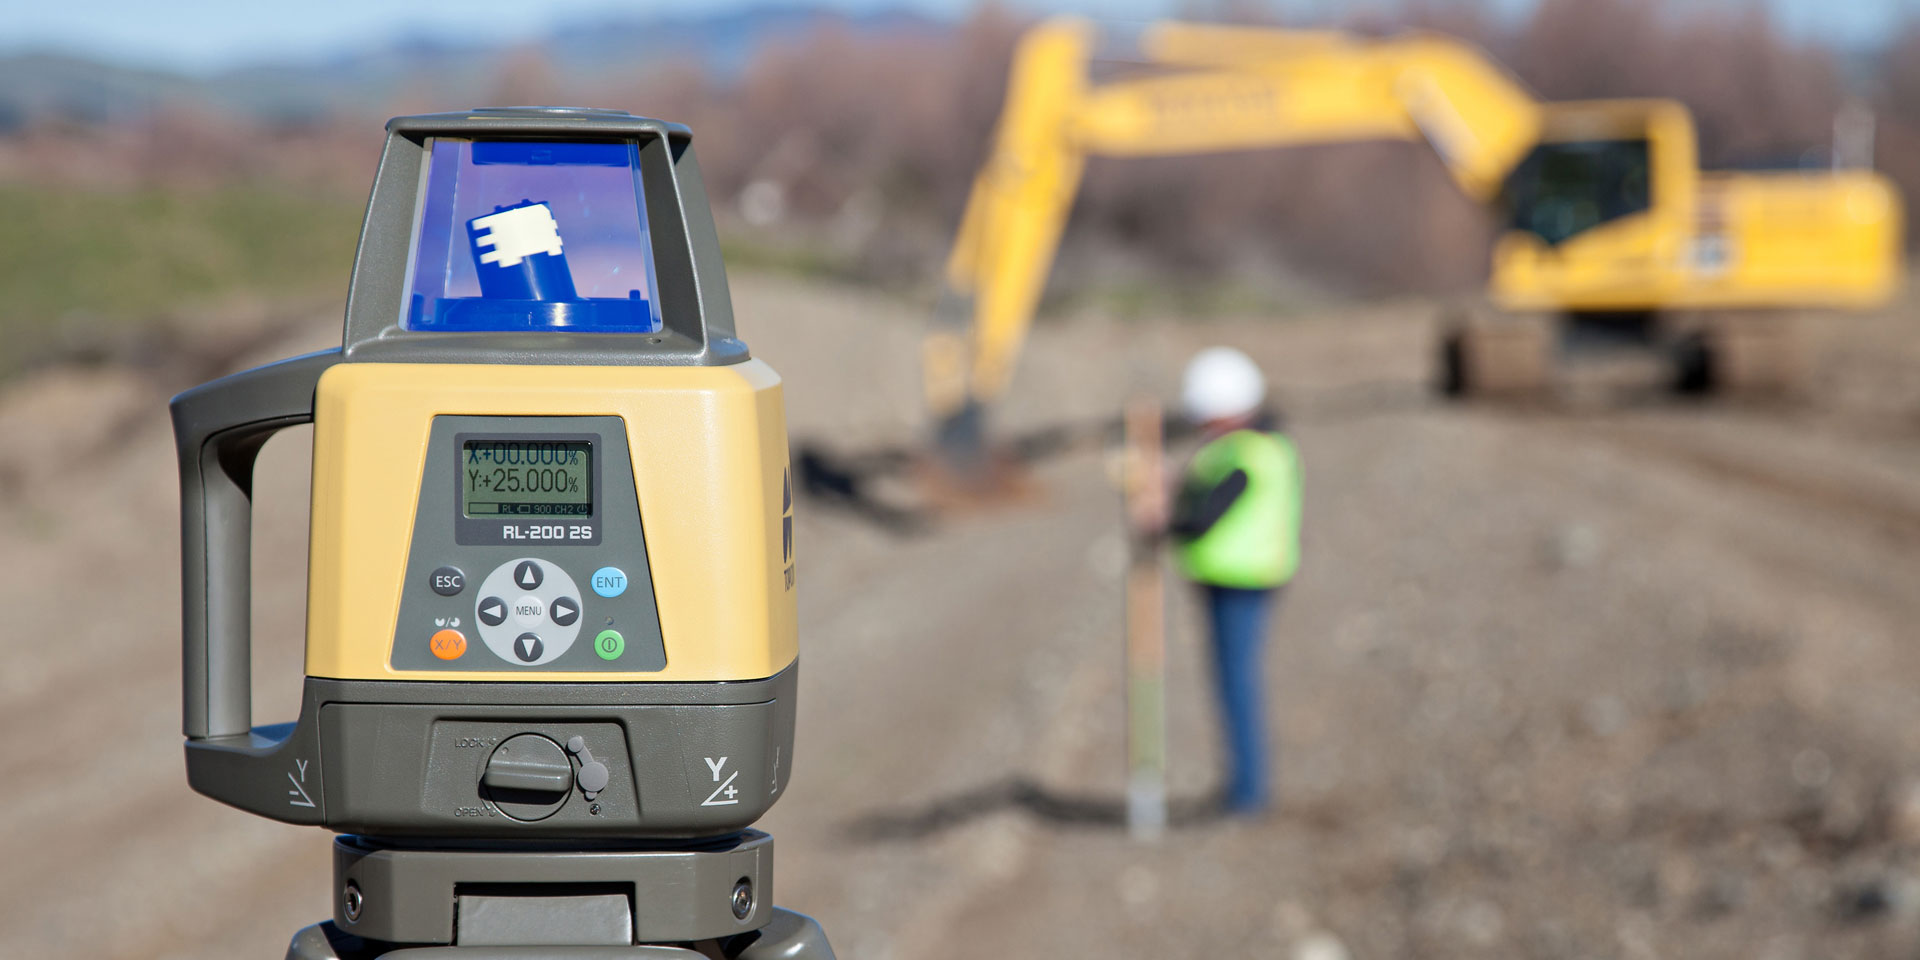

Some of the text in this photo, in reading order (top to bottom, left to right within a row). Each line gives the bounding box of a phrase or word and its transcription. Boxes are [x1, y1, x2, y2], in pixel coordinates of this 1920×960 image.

[468, 468, 578, 492] Y:+25.000%
[502, 505, 573, 514] RL 900 CH2
[503, 526, 592, 539] RL-200 2S
[436, 576, 461, 588] ESC
[596, 576, 623, 588] ENT
[516, 606, 541, 616] MENU
[435, 639, 462, 650] X/Y
[455, 737, 484, 748] LOCK
[454, 807, 483, 817] OPEN
